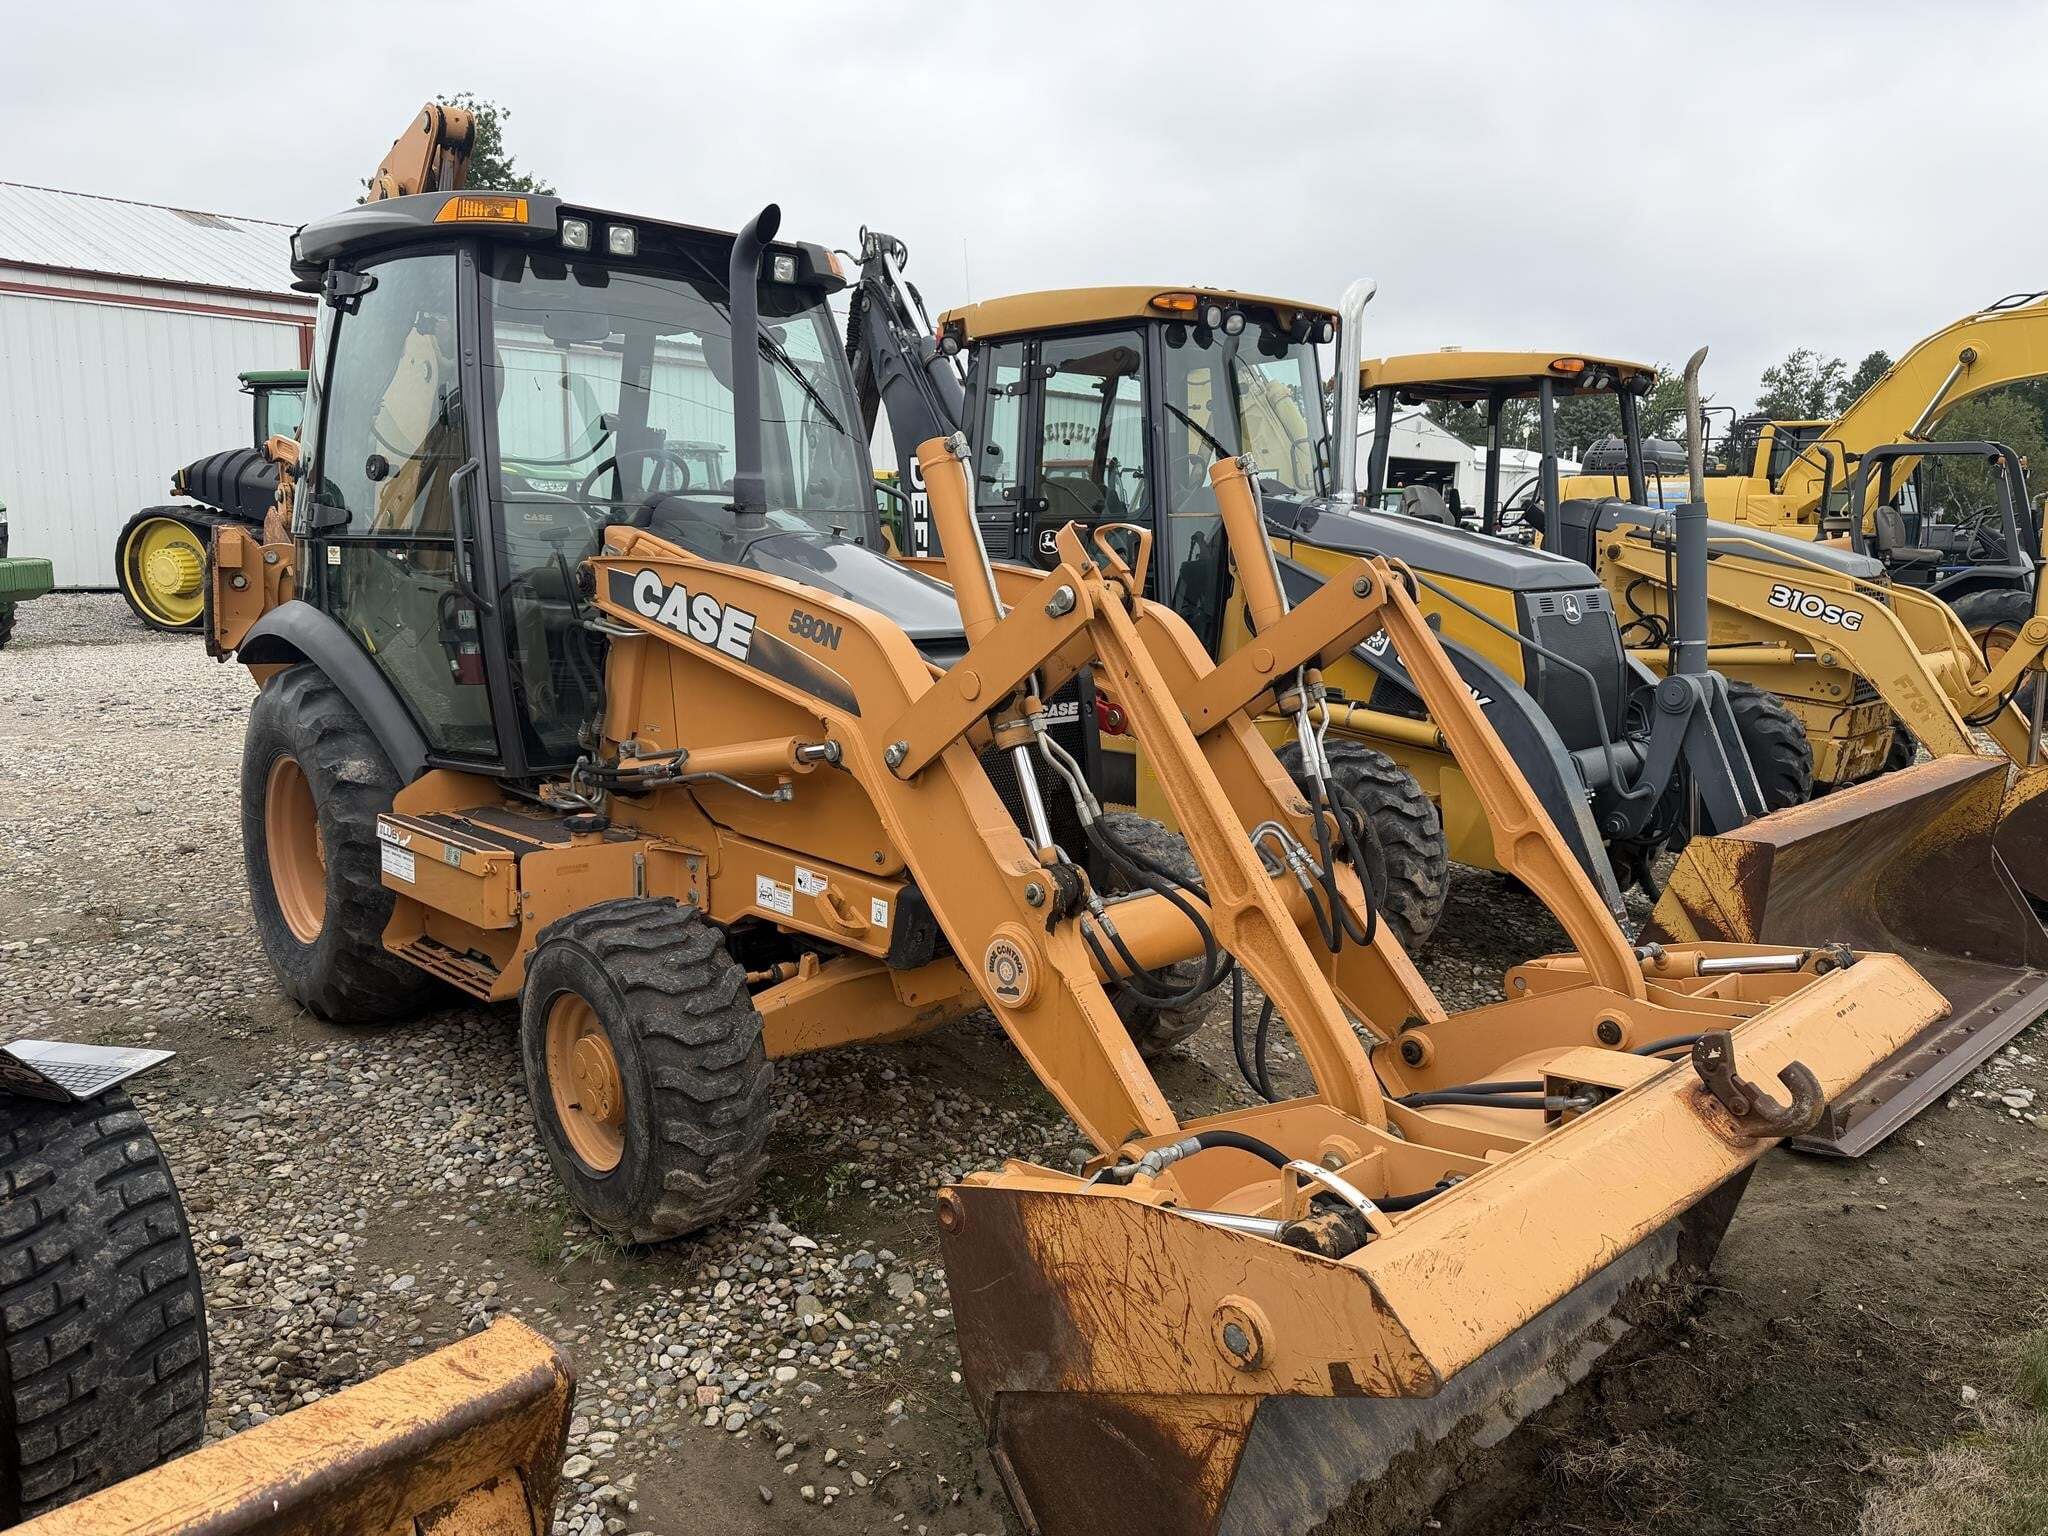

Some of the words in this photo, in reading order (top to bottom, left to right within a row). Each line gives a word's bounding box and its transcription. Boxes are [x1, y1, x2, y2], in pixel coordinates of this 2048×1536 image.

[523, 513, 552, 521] CASE
[633, 569, 756, 663] CASE
[788, 608, 842, 650] 580N
[1768, 584, 1864, 631] 310SG
